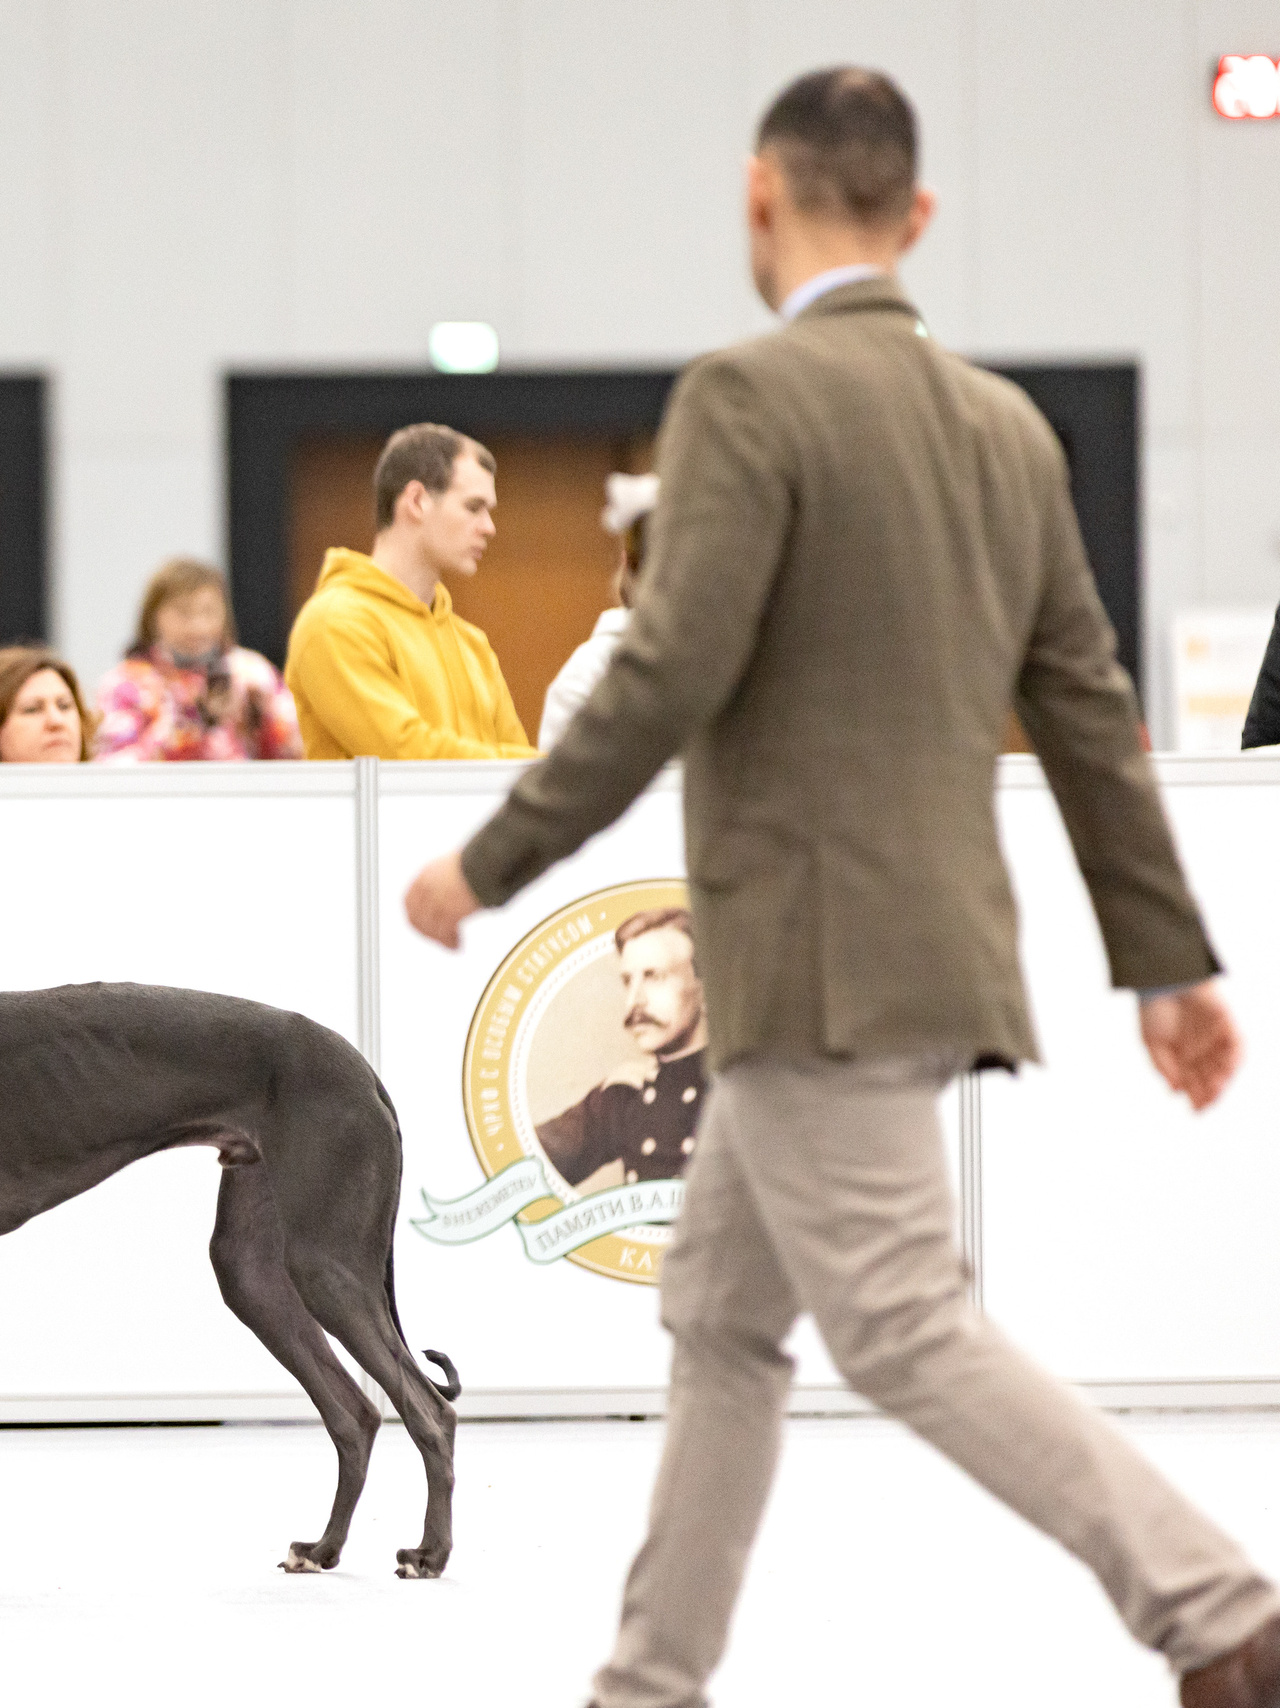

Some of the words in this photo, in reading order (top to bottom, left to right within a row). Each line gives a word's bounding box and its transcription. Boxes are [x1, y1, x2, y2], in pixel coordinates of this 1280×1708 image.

[516, 913, 594, 985] СТАТУСОМ
[535, 1200, 625, 1252] ПАМЯТИ
[620, 1246, 654, 1272] КА
